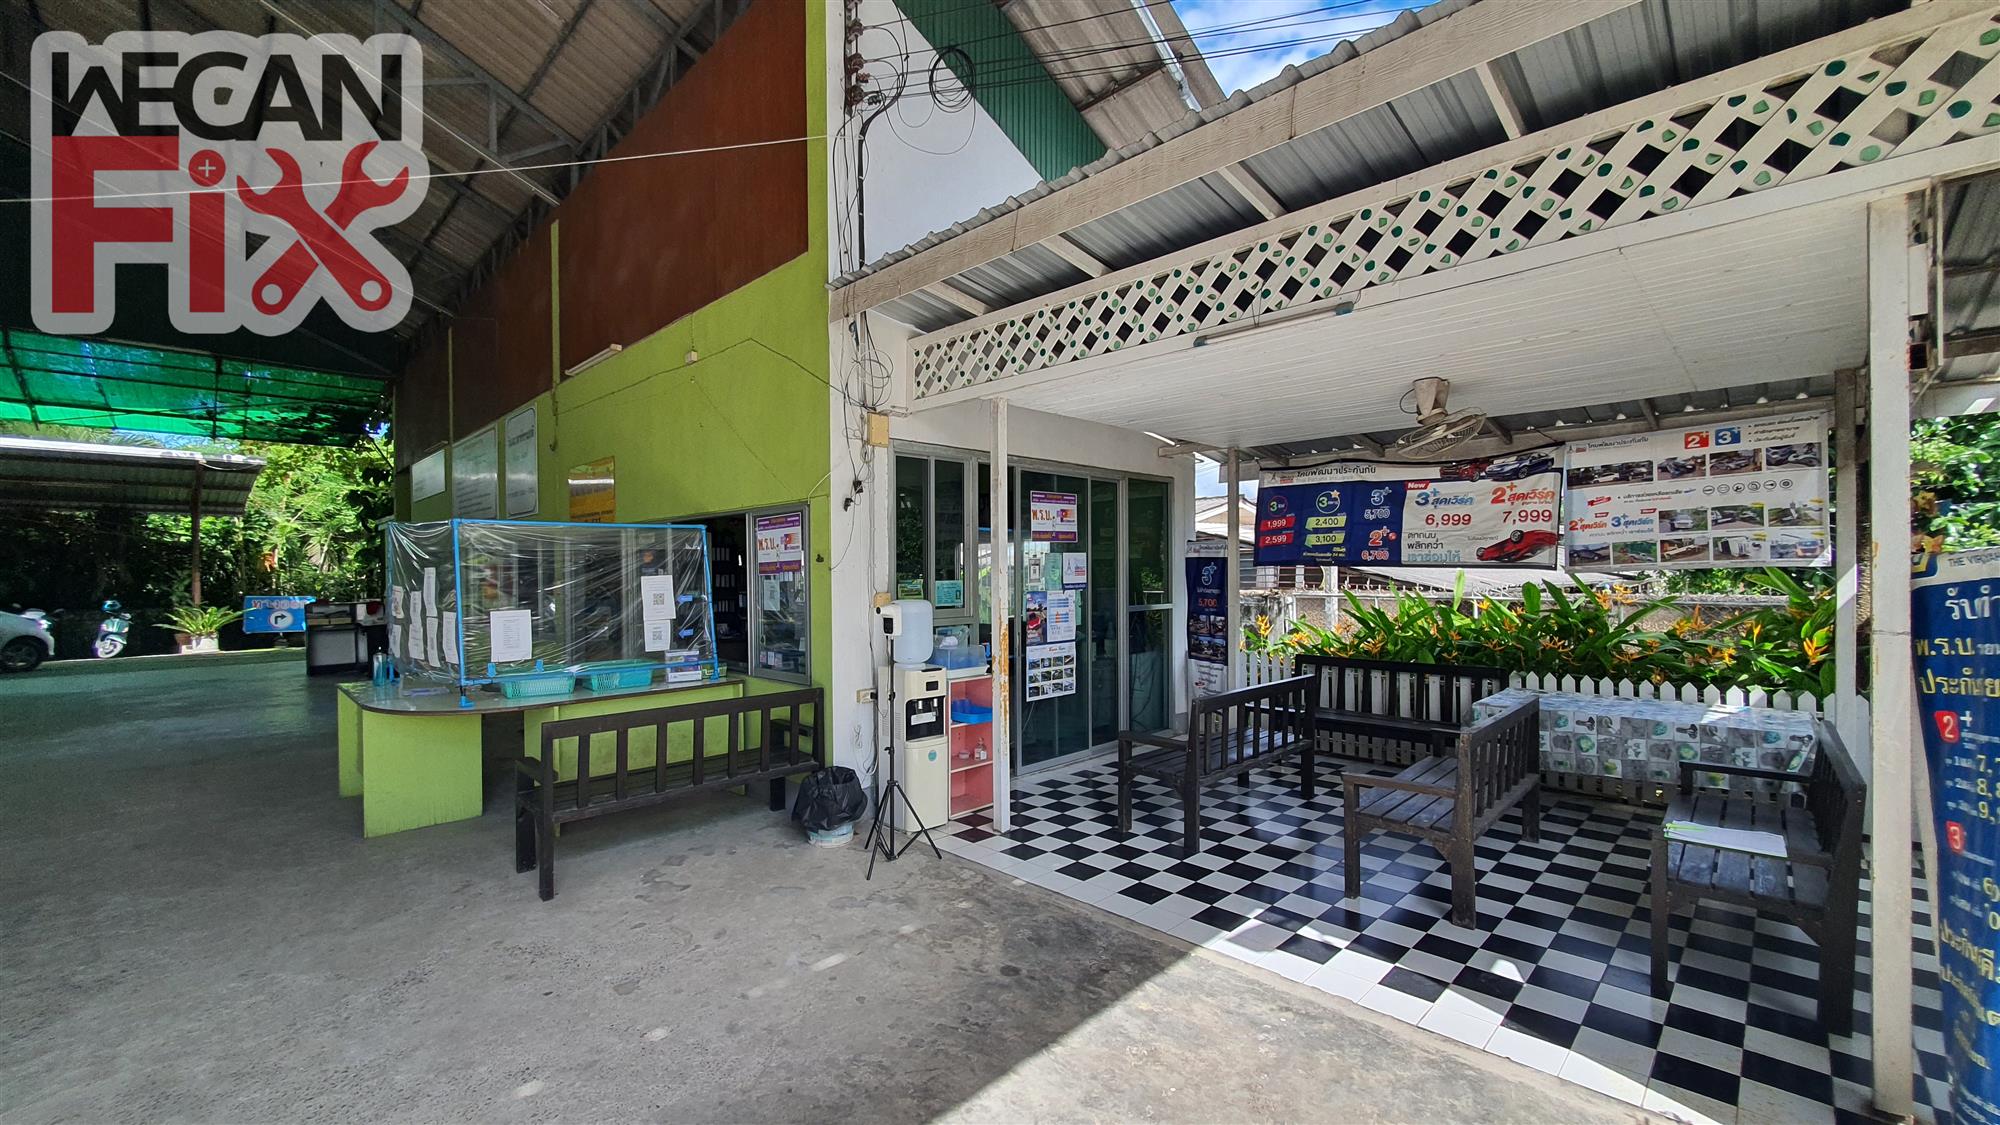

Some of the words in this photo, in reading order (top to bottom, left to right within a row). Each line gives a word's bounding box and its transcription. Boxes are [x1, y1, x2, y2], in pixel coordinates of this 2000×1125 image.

[1425, 514, 1472, 528] 6,999
[1503, 510, 1552, 525] 7,999
[1268, 519, 1287, 529] 1,999
[1315, 518, 1339, 528] 2,400
[1265, 534, 1287, 544] 2,599
[1315, 535, 1337, 544] 3,100
[1948, 557, 1966, 566] THE
